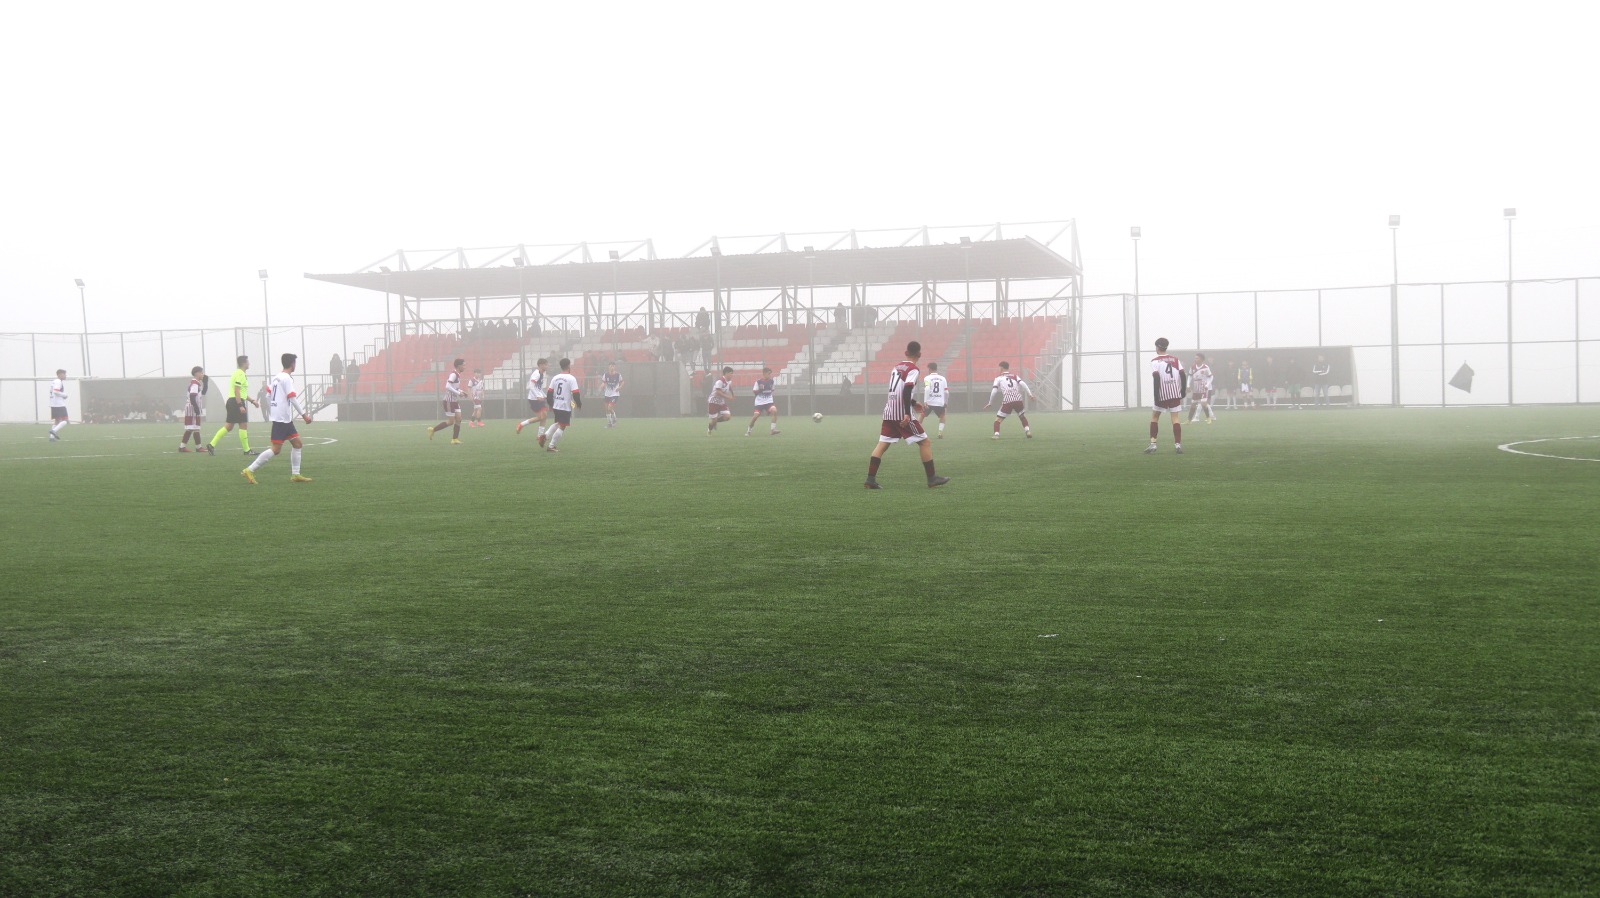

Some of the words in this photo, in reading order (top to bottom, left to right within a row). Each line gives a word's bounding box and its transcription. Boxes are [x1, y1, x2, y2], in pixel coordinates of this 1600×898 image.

[1165, 363, 1174, 379] 4
[556, 382, 563, 396] 6
[889, 371, 902, 393] 17
[933, 382, 940, 394] 8
[1006, 377, 1014, 388] 3
